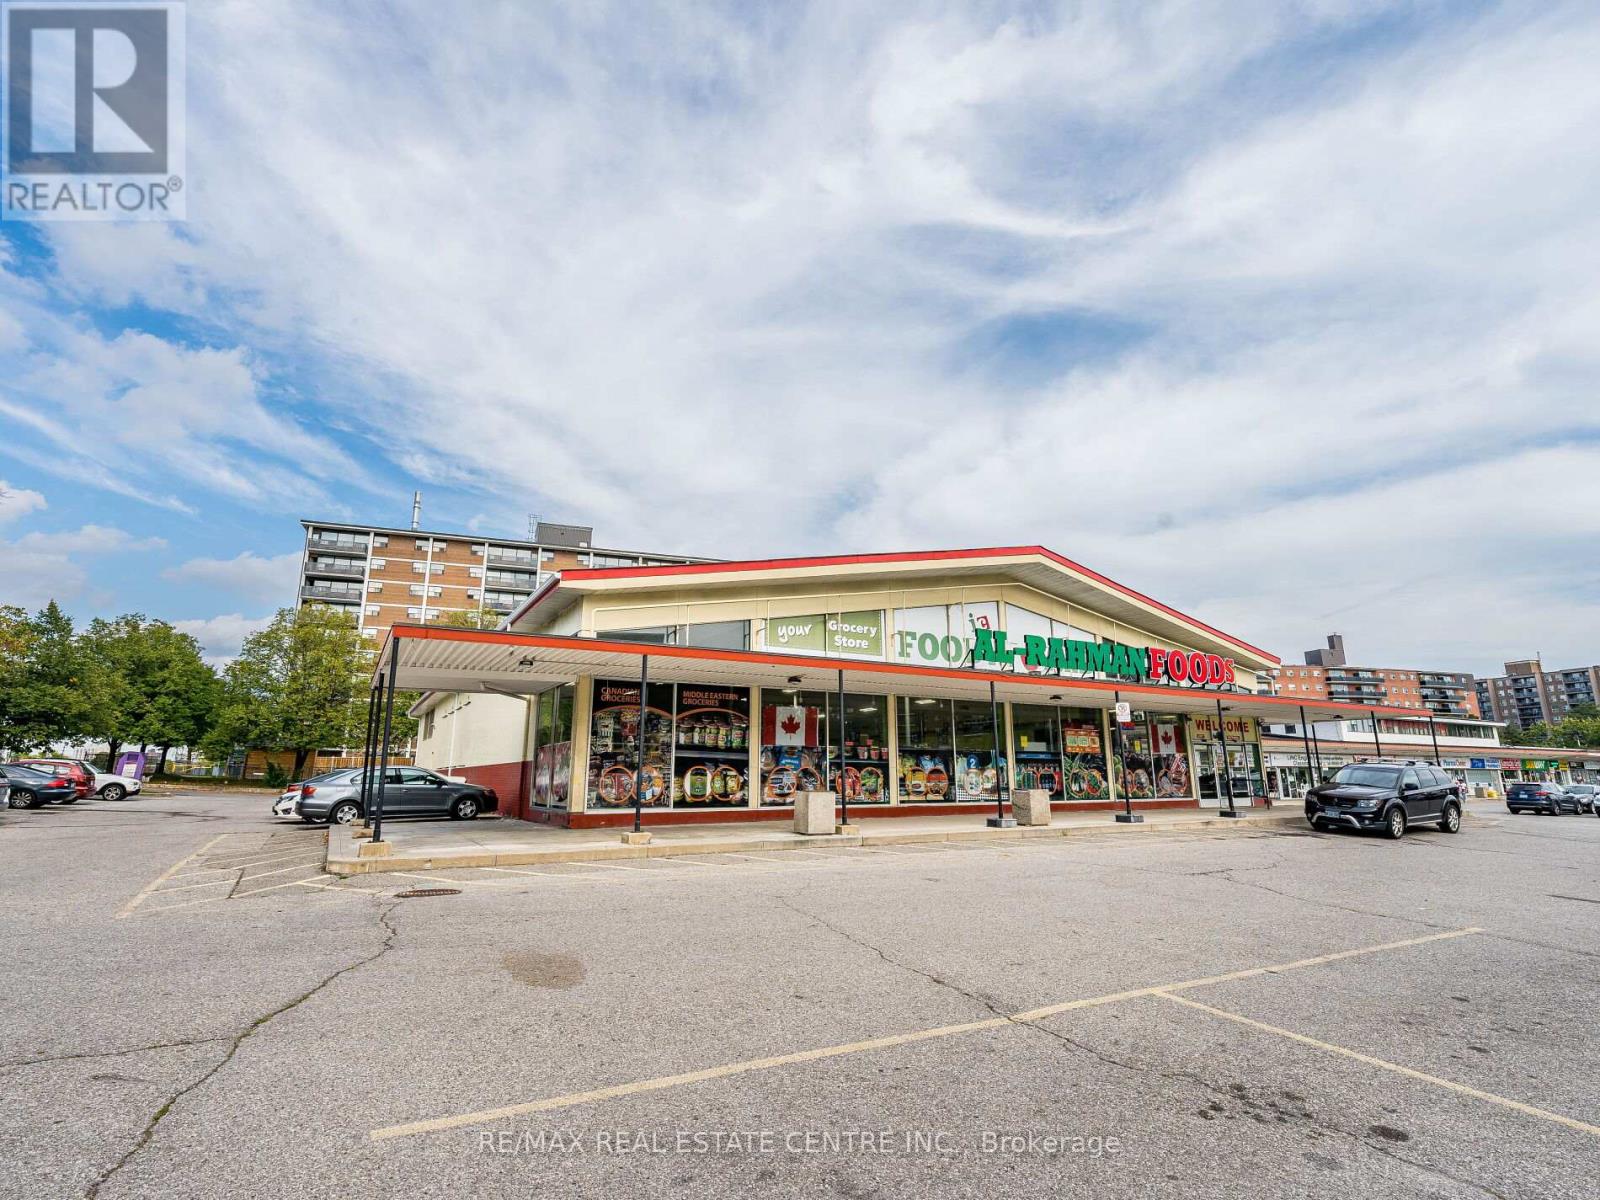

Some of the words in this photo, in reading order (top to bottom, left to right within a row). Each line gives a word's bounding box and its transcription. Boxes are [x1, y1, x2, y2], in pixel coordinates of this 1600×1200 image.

[777, 623, 813, 644] your
[828, 619, 877, 639] Grocery
[834, 635, 869, 649] Store
[973, 628, 1149, 677] AL-RAHMAN
[1147, 646, 1236, 685] FOODS
[601, 694, 641, 703] GROCERIES
[683, 690, 709, 699] MIDDLE
[710, 692, 738, 702] EASTERN
[683, 698, 719, 707] GROCERIES
[1195, 718, 1250, 733] WELOME
